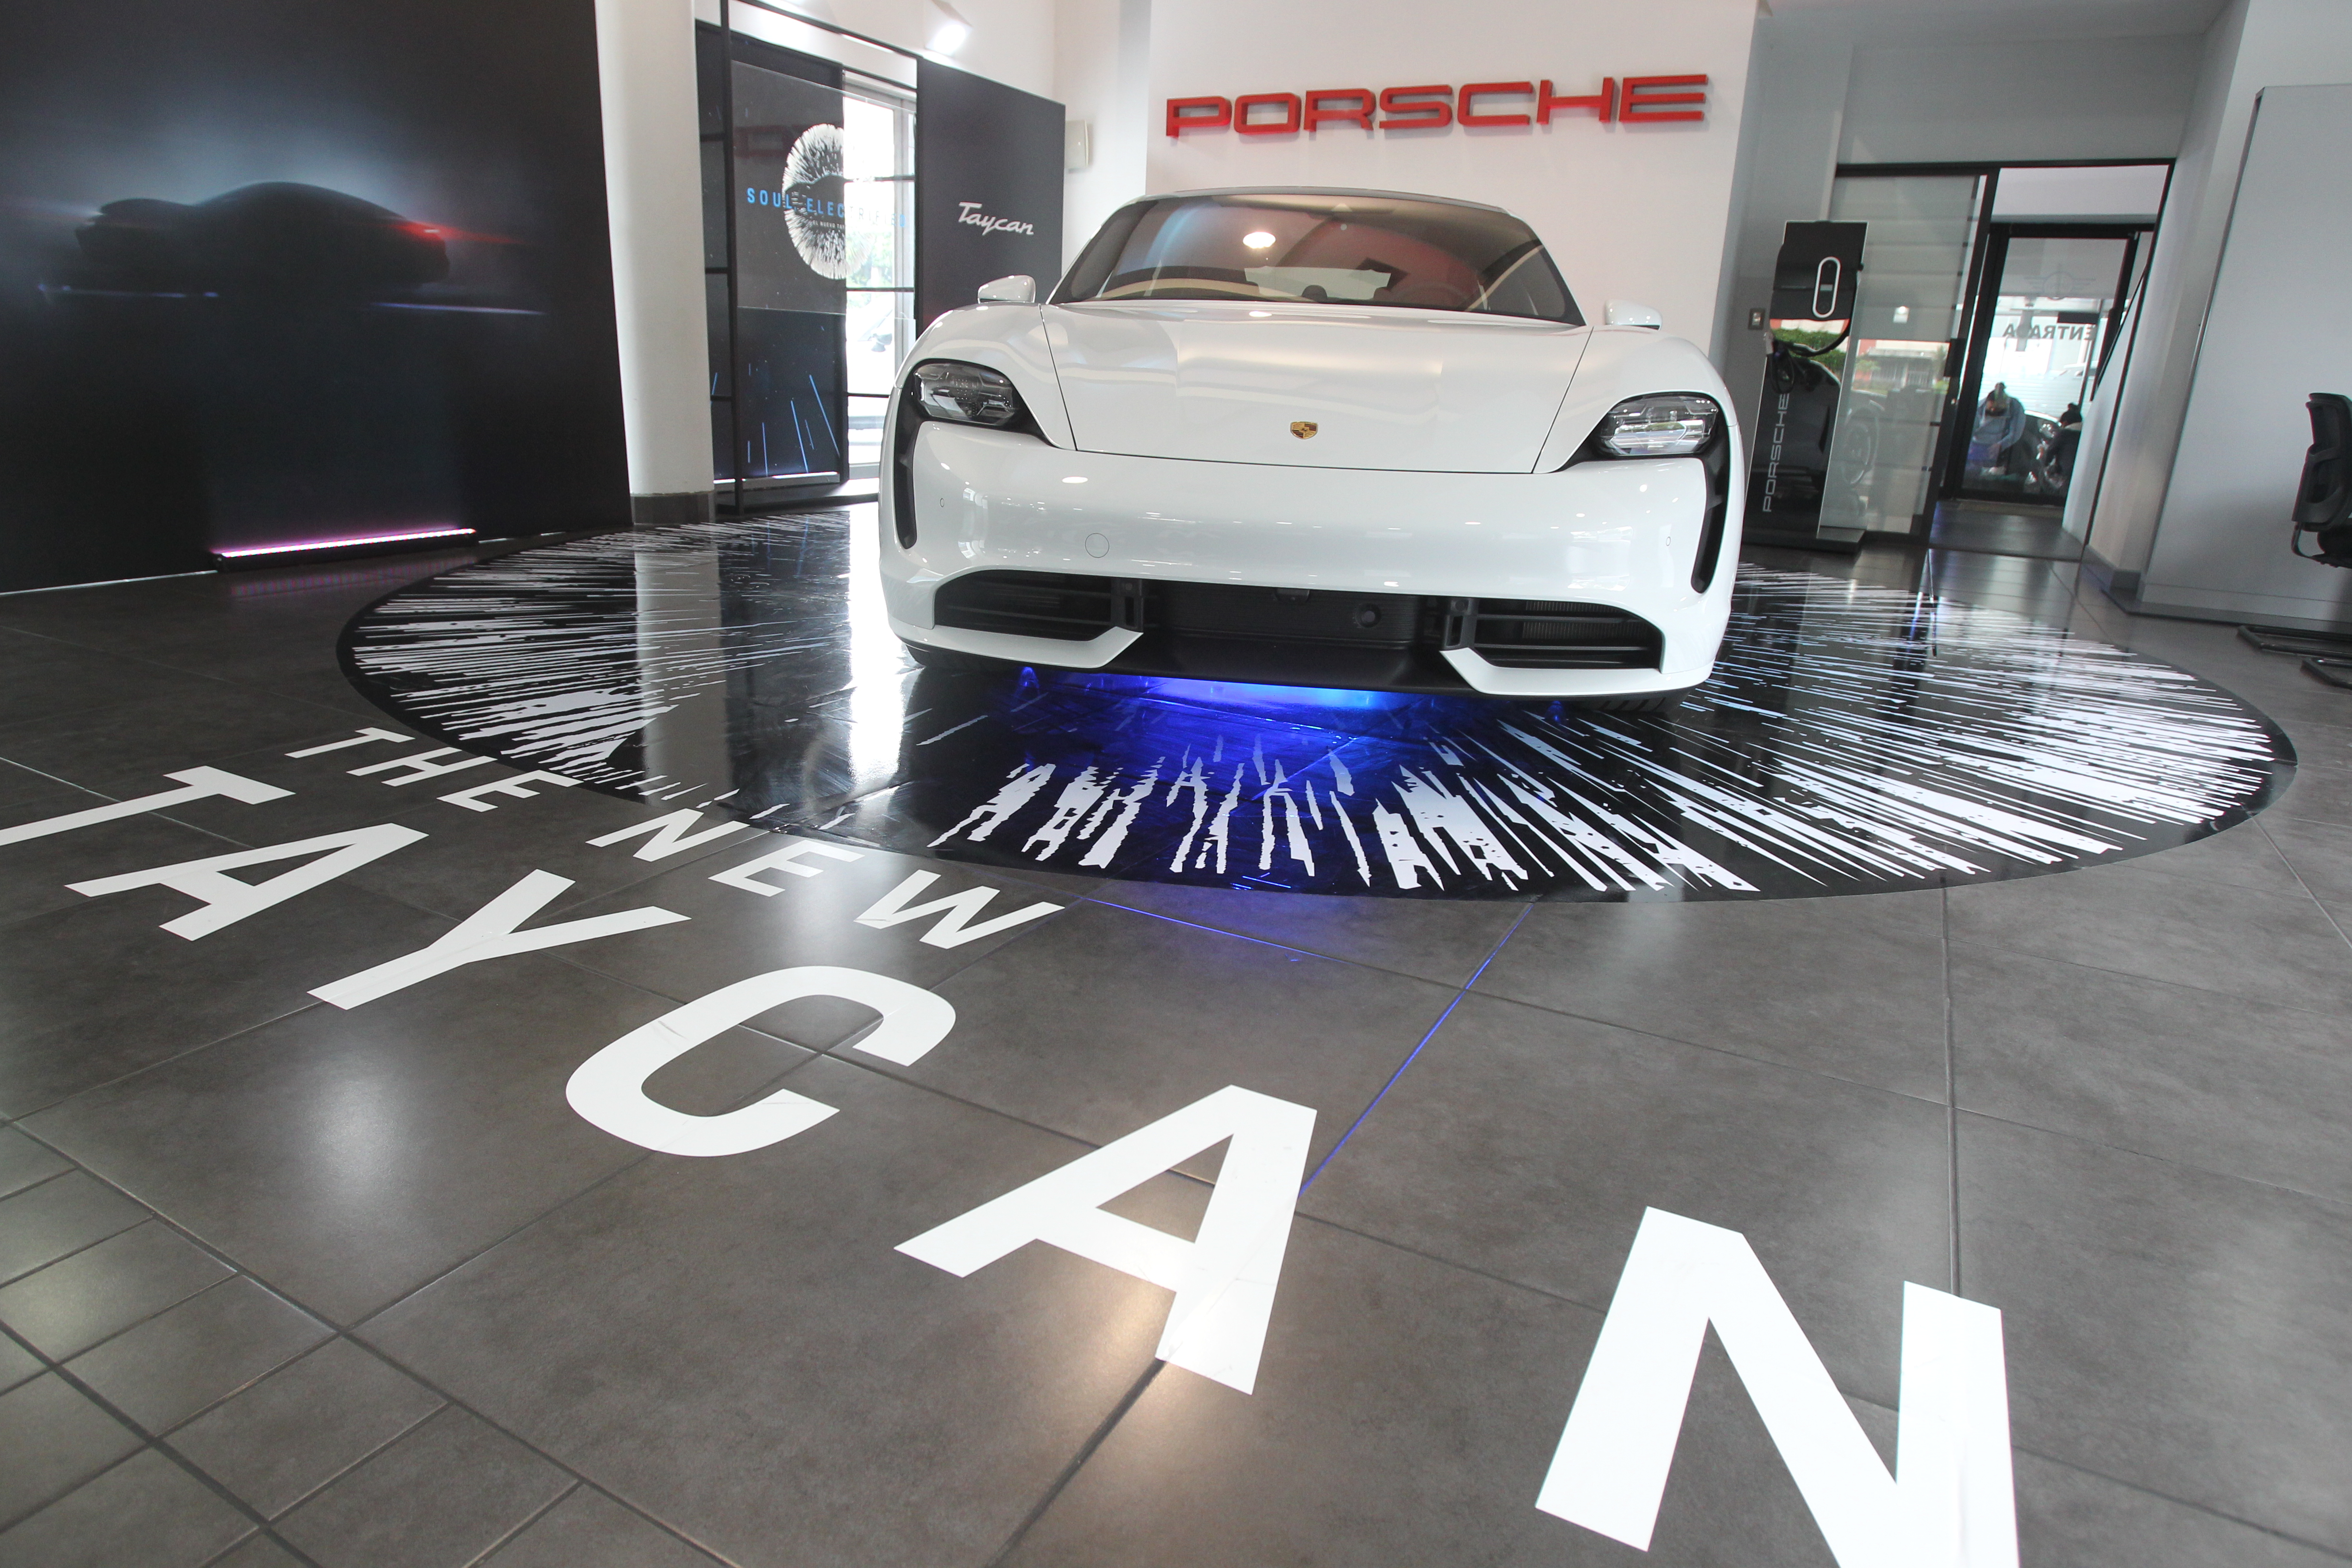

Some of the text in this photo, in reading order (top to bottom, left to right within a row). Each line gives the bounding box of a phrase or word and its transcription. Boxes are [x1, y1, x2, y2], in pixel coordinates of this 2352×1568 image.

[1166, 74, 1709, 138] PORSCHE
[958, 201, 1034, 236] Taycan
[1763, 392, 1790, 512] PORSCHE
[284, 727, 1066, 949] THE NEW
[0, 765, 2021, 1568] TAYCAN
